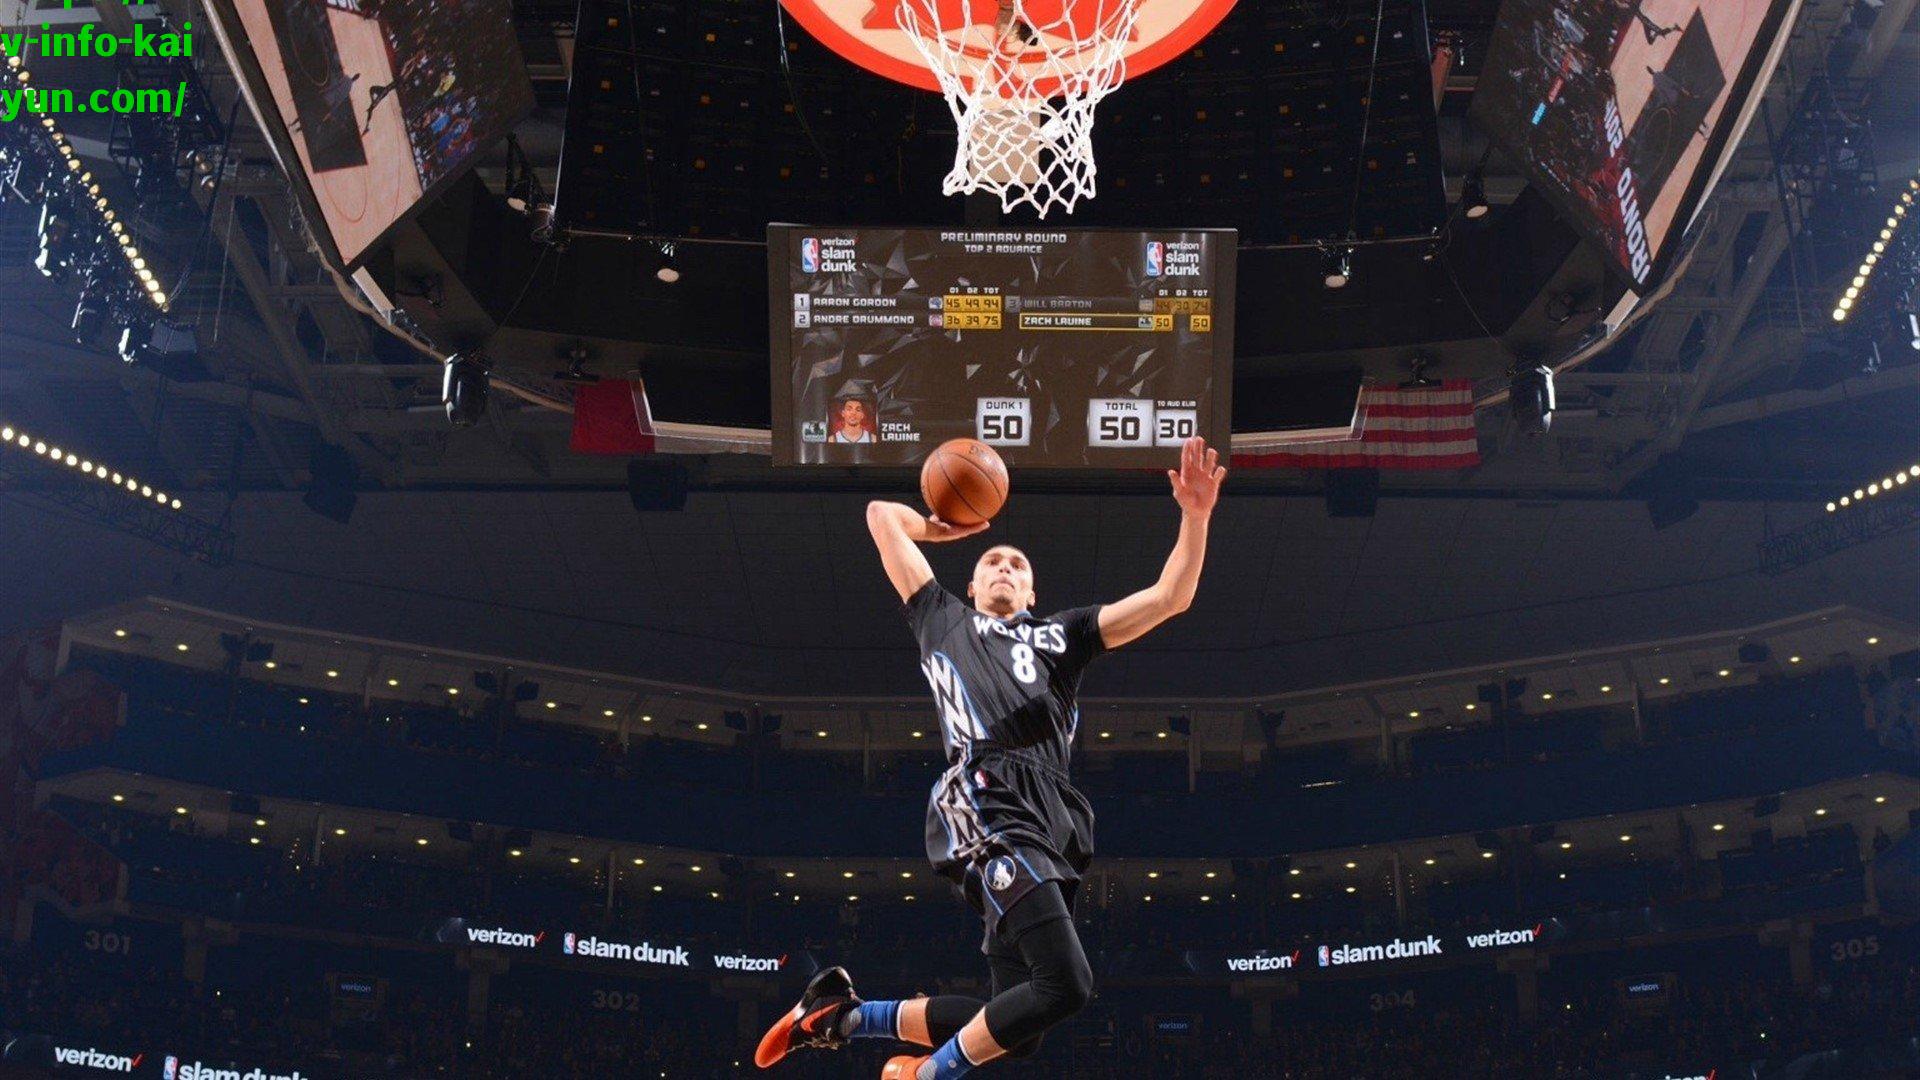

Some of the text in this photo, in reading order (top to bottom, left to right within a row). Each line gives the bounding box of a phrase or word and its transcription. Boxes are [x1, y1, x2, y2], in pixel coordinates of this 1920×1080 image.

[821, 237, 855, 246] verizon
[941, 232, 1067, 243] PRELIMINARY ROUND
[821, 246, 856, 260] slam
[965, 244, 984, 253] TOP
[987, 244, 993, 253] 2
[1166, 243, 1199, 251] verizon
[1165, 252, 1199, 264] slam
[821, 259, 857, 273] dunk
[1165, 264, 1200, 277] dunk
[797, 297, 999, 309] 1 AARON GORDON 45 49 94
[1024, 299, 1046, 309] WILL
[798, 314, 806, 324] 2
[813, 315, 849, 324] ANDRE
[852, 315, 915, 324] DRUMMOND
[965, 315, 980, 325] 39
[984, 315, 999, 325] 75
[1024, 316, 1051, 326] ZACH
[1156, 318, 1170, 327] 50
[1193, 318, 1208, 327] 50
[986, 401, 1015, 409] DUNK
[1106, 403, 1138, 411] TOTAL
[881, 423, 910, 432] ZACH
[983, 415, 1022, 439] 50
[1100, 417, 1141, 441] 50
[1159, 419, 1193, 438] 30
[973, 615, 1066, 654] WOLVES
[1011, 643, 1036, 683] 8
[467, 927, 535, 948] verizon
[1467, 927, 1533, 949] verizon
[577, 936, 689, 967] slam dunk
[1331, 935, 1442, 966] slam dunk
[713, 954, 779, 971] verizon
[1227, 954, 1293, 972] verizon
[54, 1046, 132, 1072] verizon
